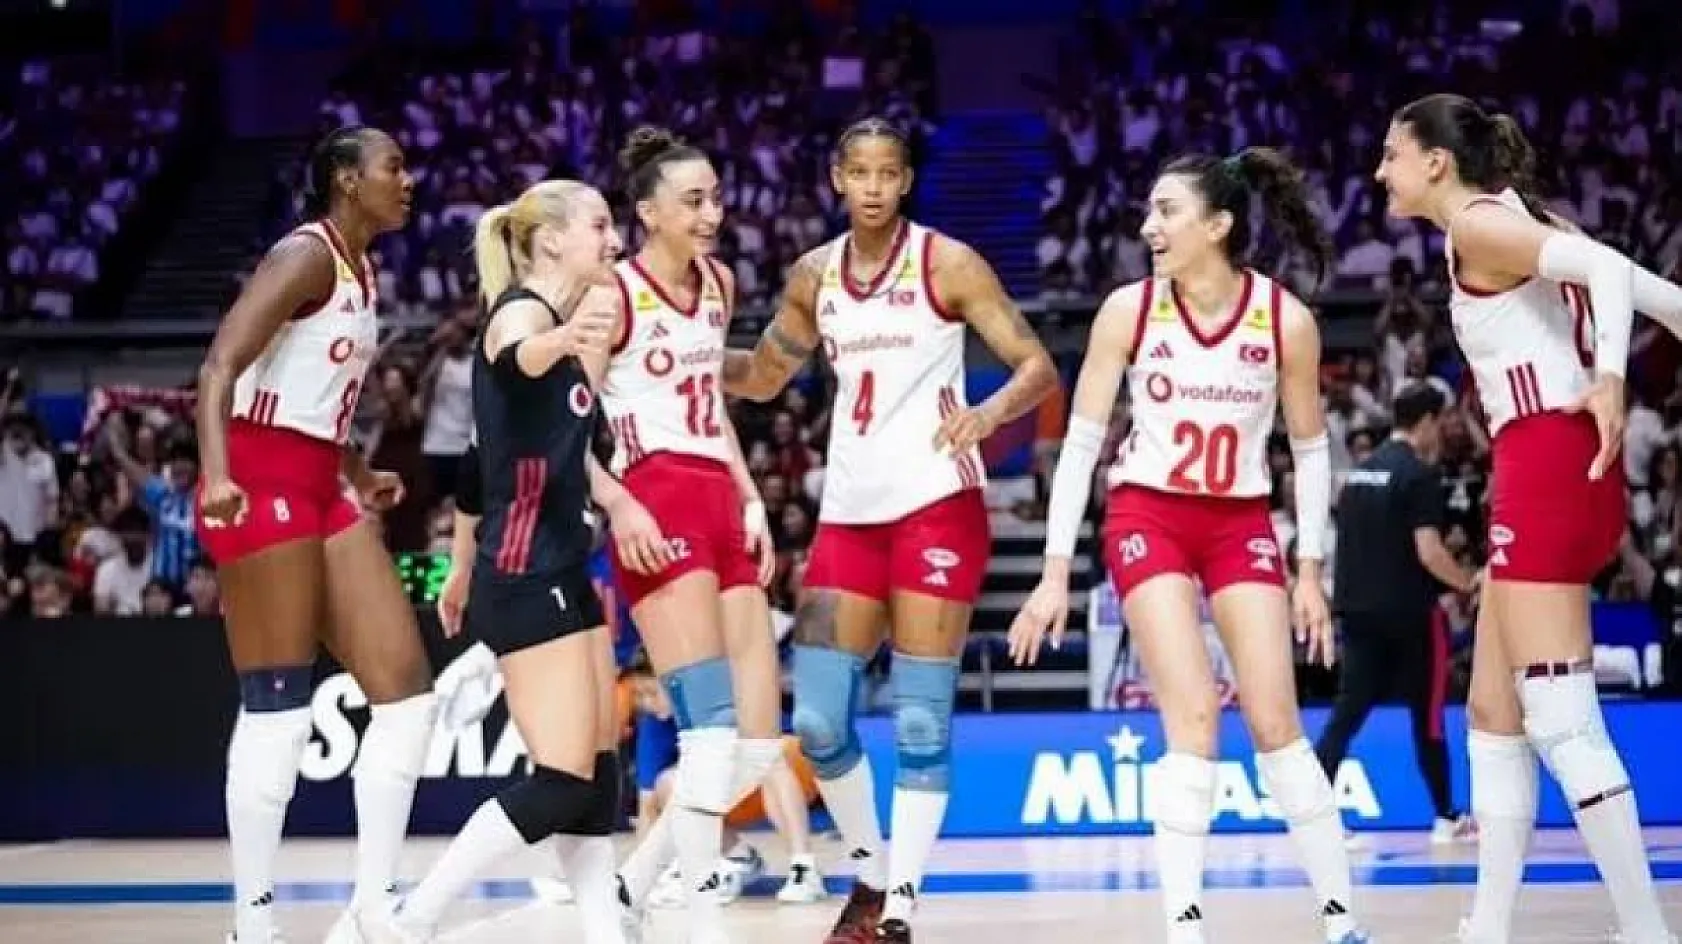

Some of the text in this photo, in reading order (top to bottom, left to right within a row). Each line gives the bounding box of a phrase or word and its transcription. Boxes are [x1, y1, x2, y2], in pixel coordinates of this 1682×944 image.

[674, 374, 721, 438] 12
[851, 370, 875, 436] 4
[1178, 384, 1264, 403] vodafone
[1167, 420, 1238, 494] 20
[273, 497, 290, 522] 8
[1119, 533, 1148, 565] 20
[551, 586, 567, 611] 1
